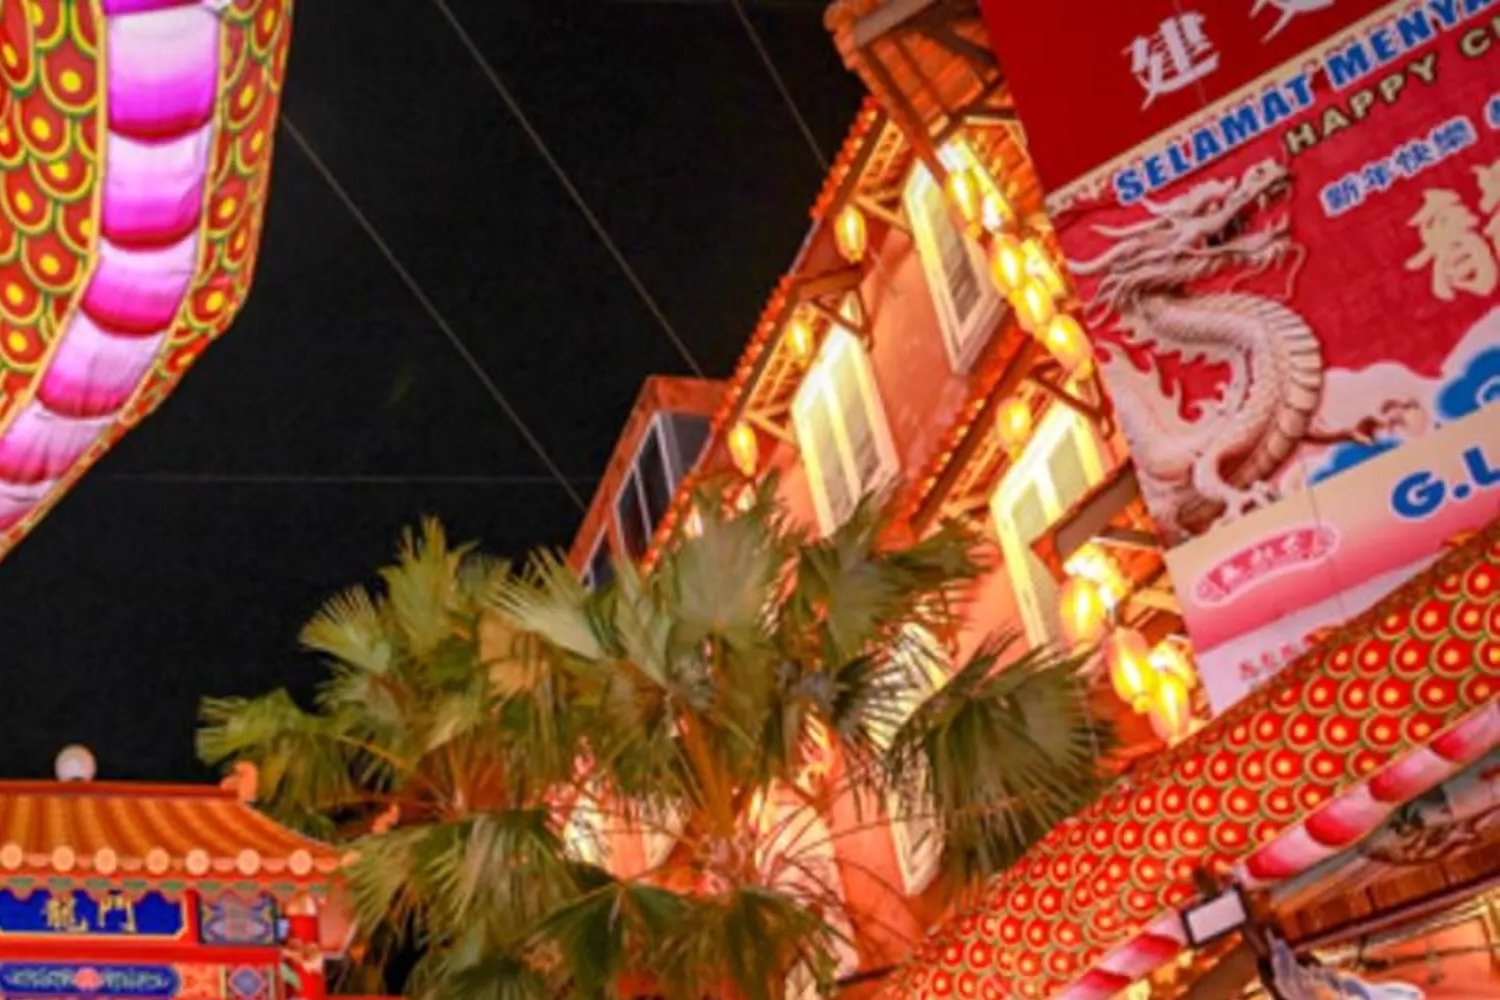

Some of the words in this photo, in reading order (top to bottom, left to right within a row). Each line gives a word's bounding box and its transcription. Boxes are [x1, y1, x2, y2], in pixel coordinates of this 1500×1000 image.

[1114, 73, 1315, 204] SELAMAT
[1286, 52, 1437, 154] HAPPY
[1460, 13, 1500, 58] C
